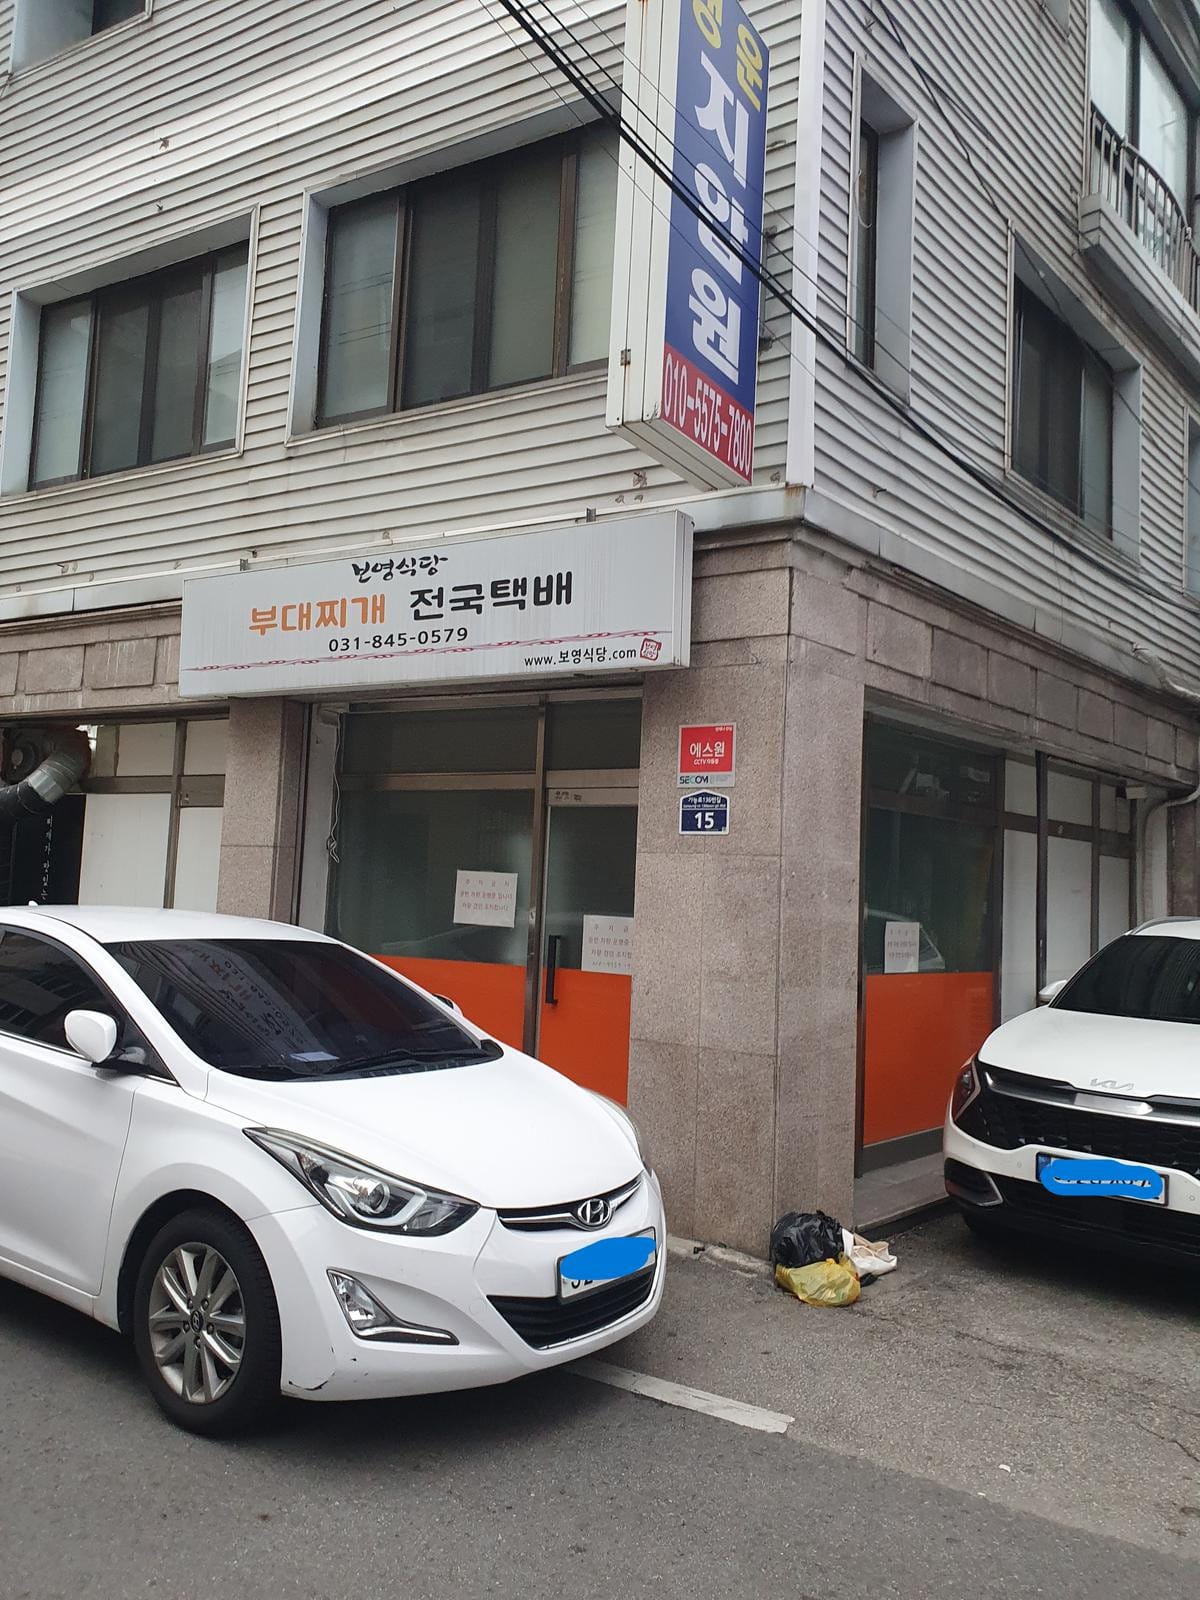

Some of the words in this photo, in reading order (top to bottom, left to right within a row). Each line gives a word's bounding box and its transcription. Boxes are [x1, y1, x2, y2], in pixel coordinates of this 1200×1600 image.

[688, 49, 750, 386] 지압원
[664, 352, 752, 476] 010-5575-7800
[249, 593, 387, 636] 부대찌개
[409, 571, 574, 621] 전국택배
[328, 626, 469, 653] 031-845-0579
[524, 645, 637, 668] www.보영식당.com
[689, 741, 725, 758] 에스원
[679, 775, 709, 784] SECOM
[695, 811, 715, 829] 15
